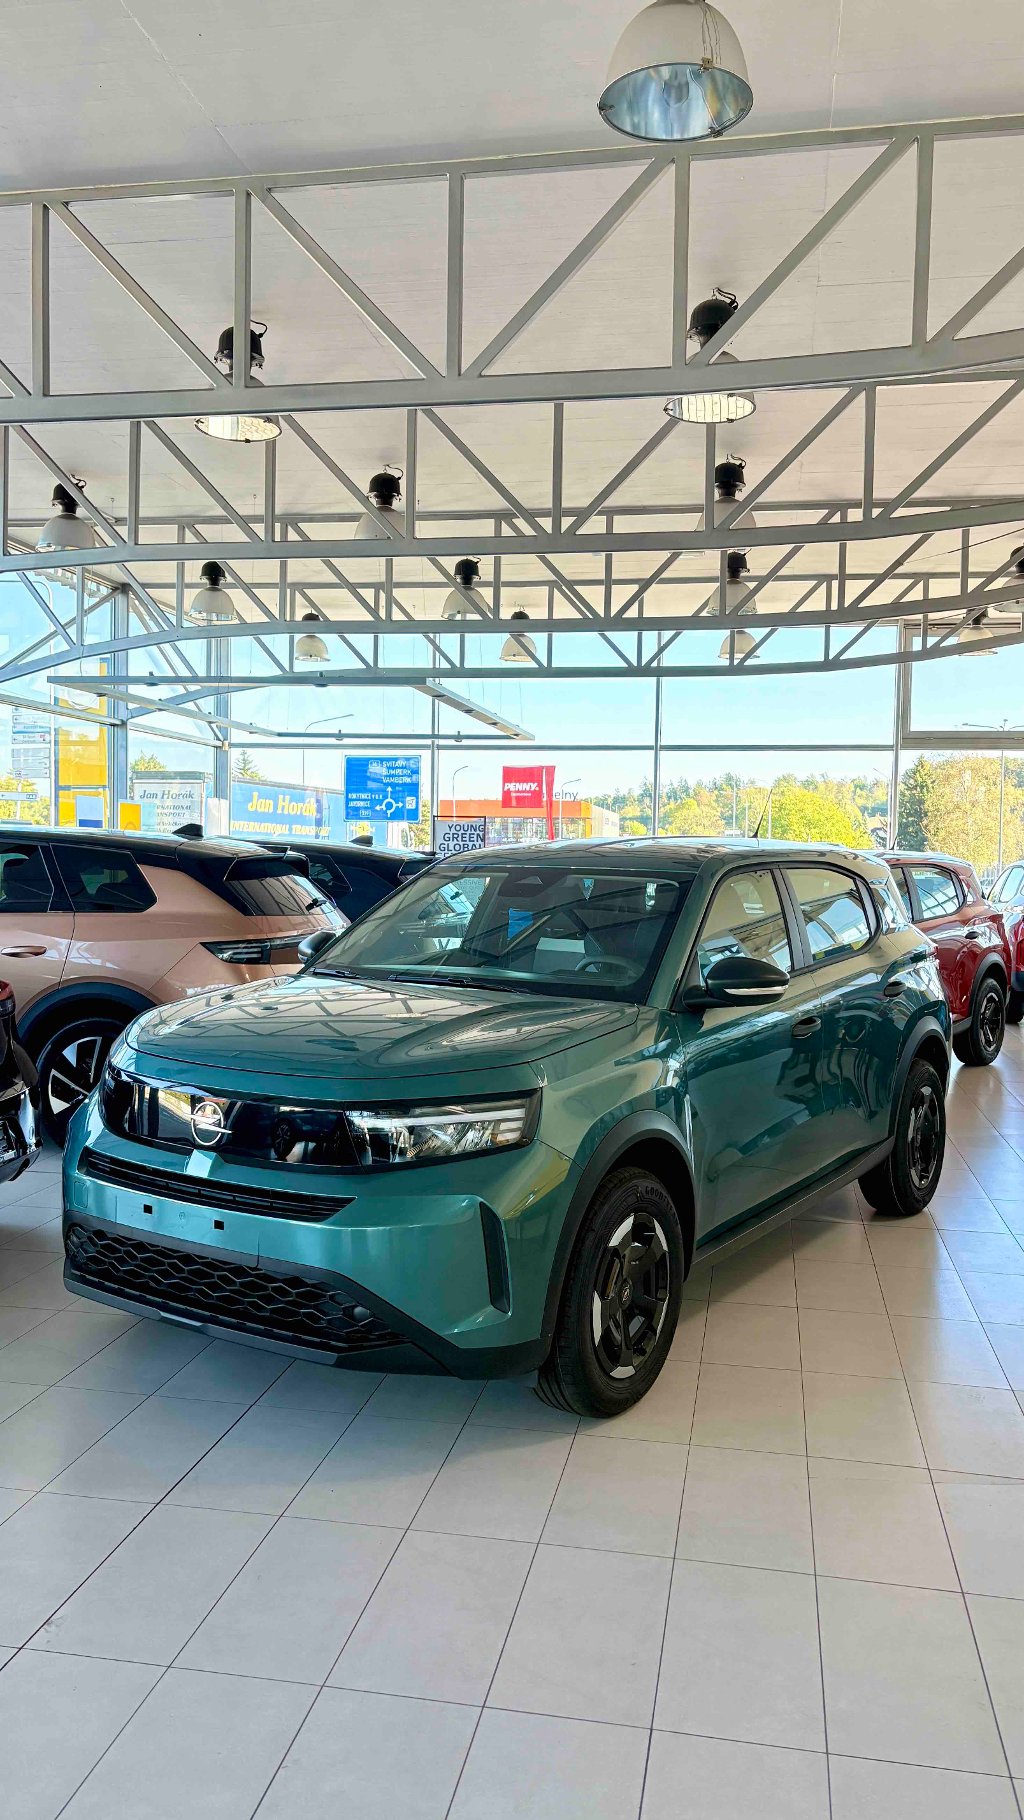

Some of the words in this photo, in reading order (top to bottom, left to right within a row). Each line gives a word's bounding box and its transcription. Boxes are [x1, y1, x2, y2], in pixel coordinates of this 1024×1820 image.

[382, 760, 407, 768] SVITAVY
[382, 776, 412, 784] VAMBERK
[139, 789, 158, 799] Jan
[160, 789, 195, 800] Horák
[247, 791, 274, 813] Jan
[276, 794, 317, 816] Horák
[447, 823, 485, 833] YOUNG
[443, 832, 485, 843] GREEN
